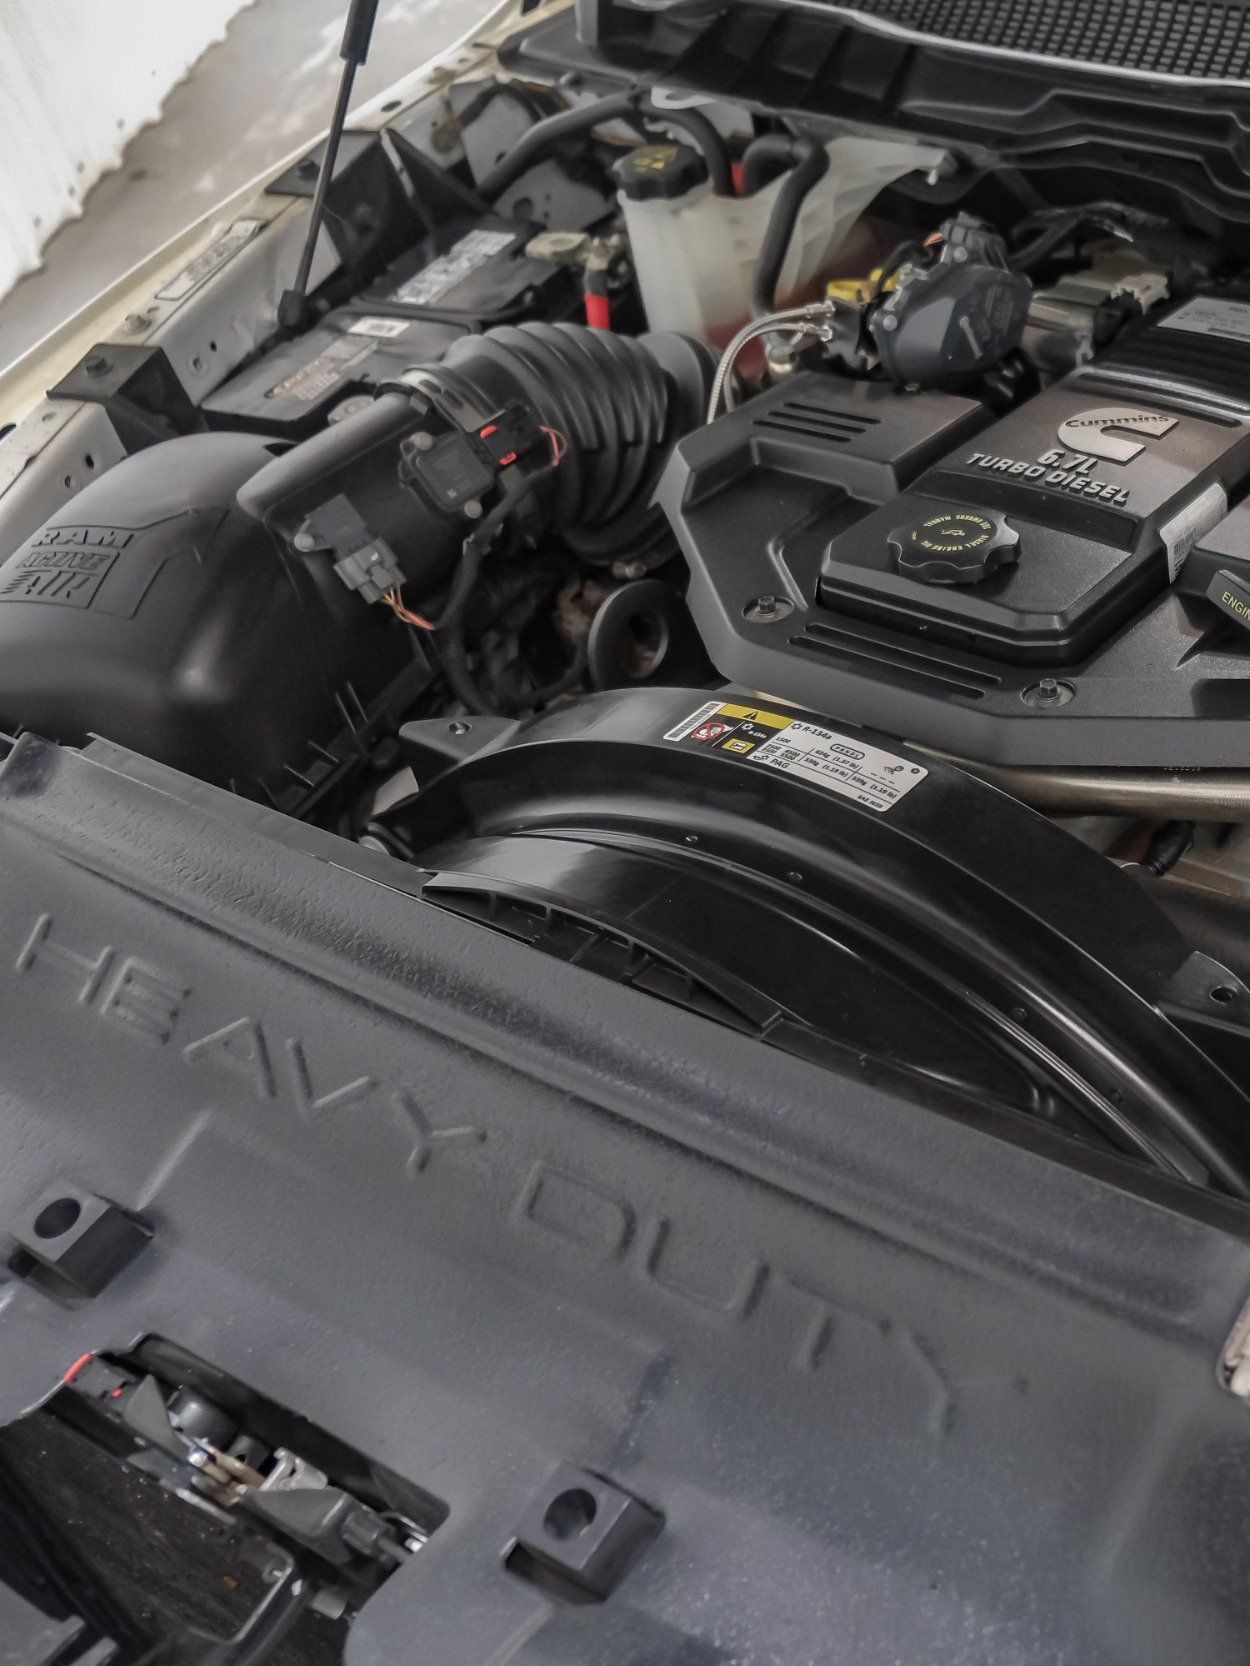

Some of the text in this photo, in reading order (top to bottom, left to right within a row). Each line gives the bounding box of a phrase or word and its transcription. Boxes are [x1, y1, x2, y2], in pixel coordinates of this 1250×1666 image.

[1065, 413, 1170, 428] Cummins
[1037, 449, 1098, 475] 6.7L
[966, 452, 1130, 505] TURBO DIESEL
[31, 530, 134, 549] RAM
[16, 551, 110, 570] ACTIVE
[22, 571, 99, 599] AIR
[803, 725, 832, 741] R-134a
[770, 758, 790, 768] PAG
[15, 912, 1031, 1442] HEAVY DUTY
